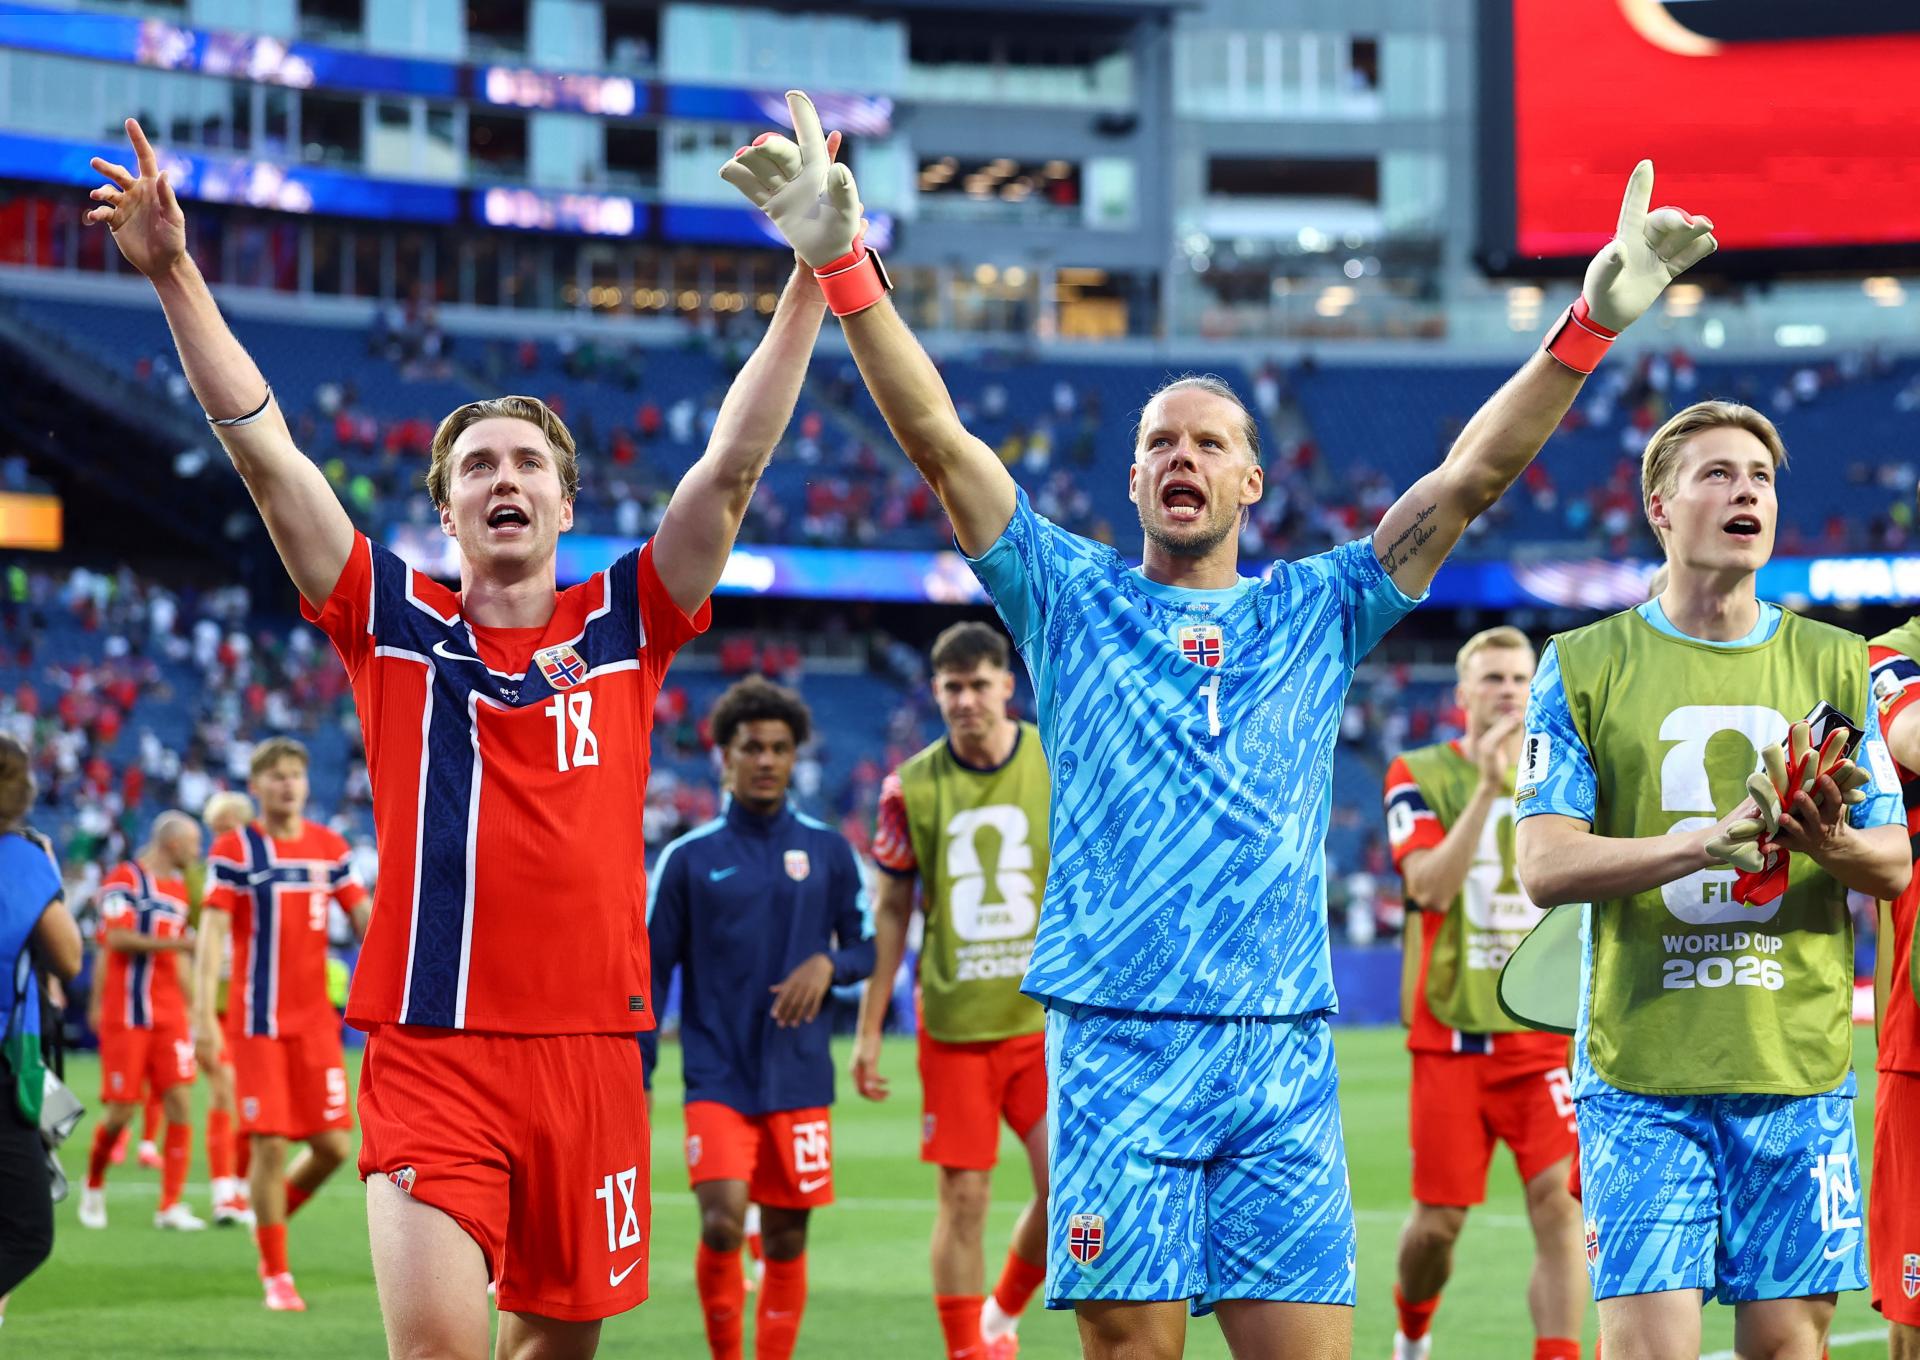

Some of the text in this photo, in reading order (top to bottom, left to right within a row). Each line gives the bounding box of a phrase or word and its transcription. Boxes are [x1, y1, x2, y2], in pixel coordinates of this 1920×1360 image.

[545, 690, 599, 773] 18
[1199, 675, 1222, 737] 1
[1702, 881, 1734, 904] FI
[1662, 931, 1783, 955] WORLD CUP
[1662, 955, 1785, 991] 2026
[595, 1165, 641, 1252] 18
[1810, 1152, 1861, 1232] 12
